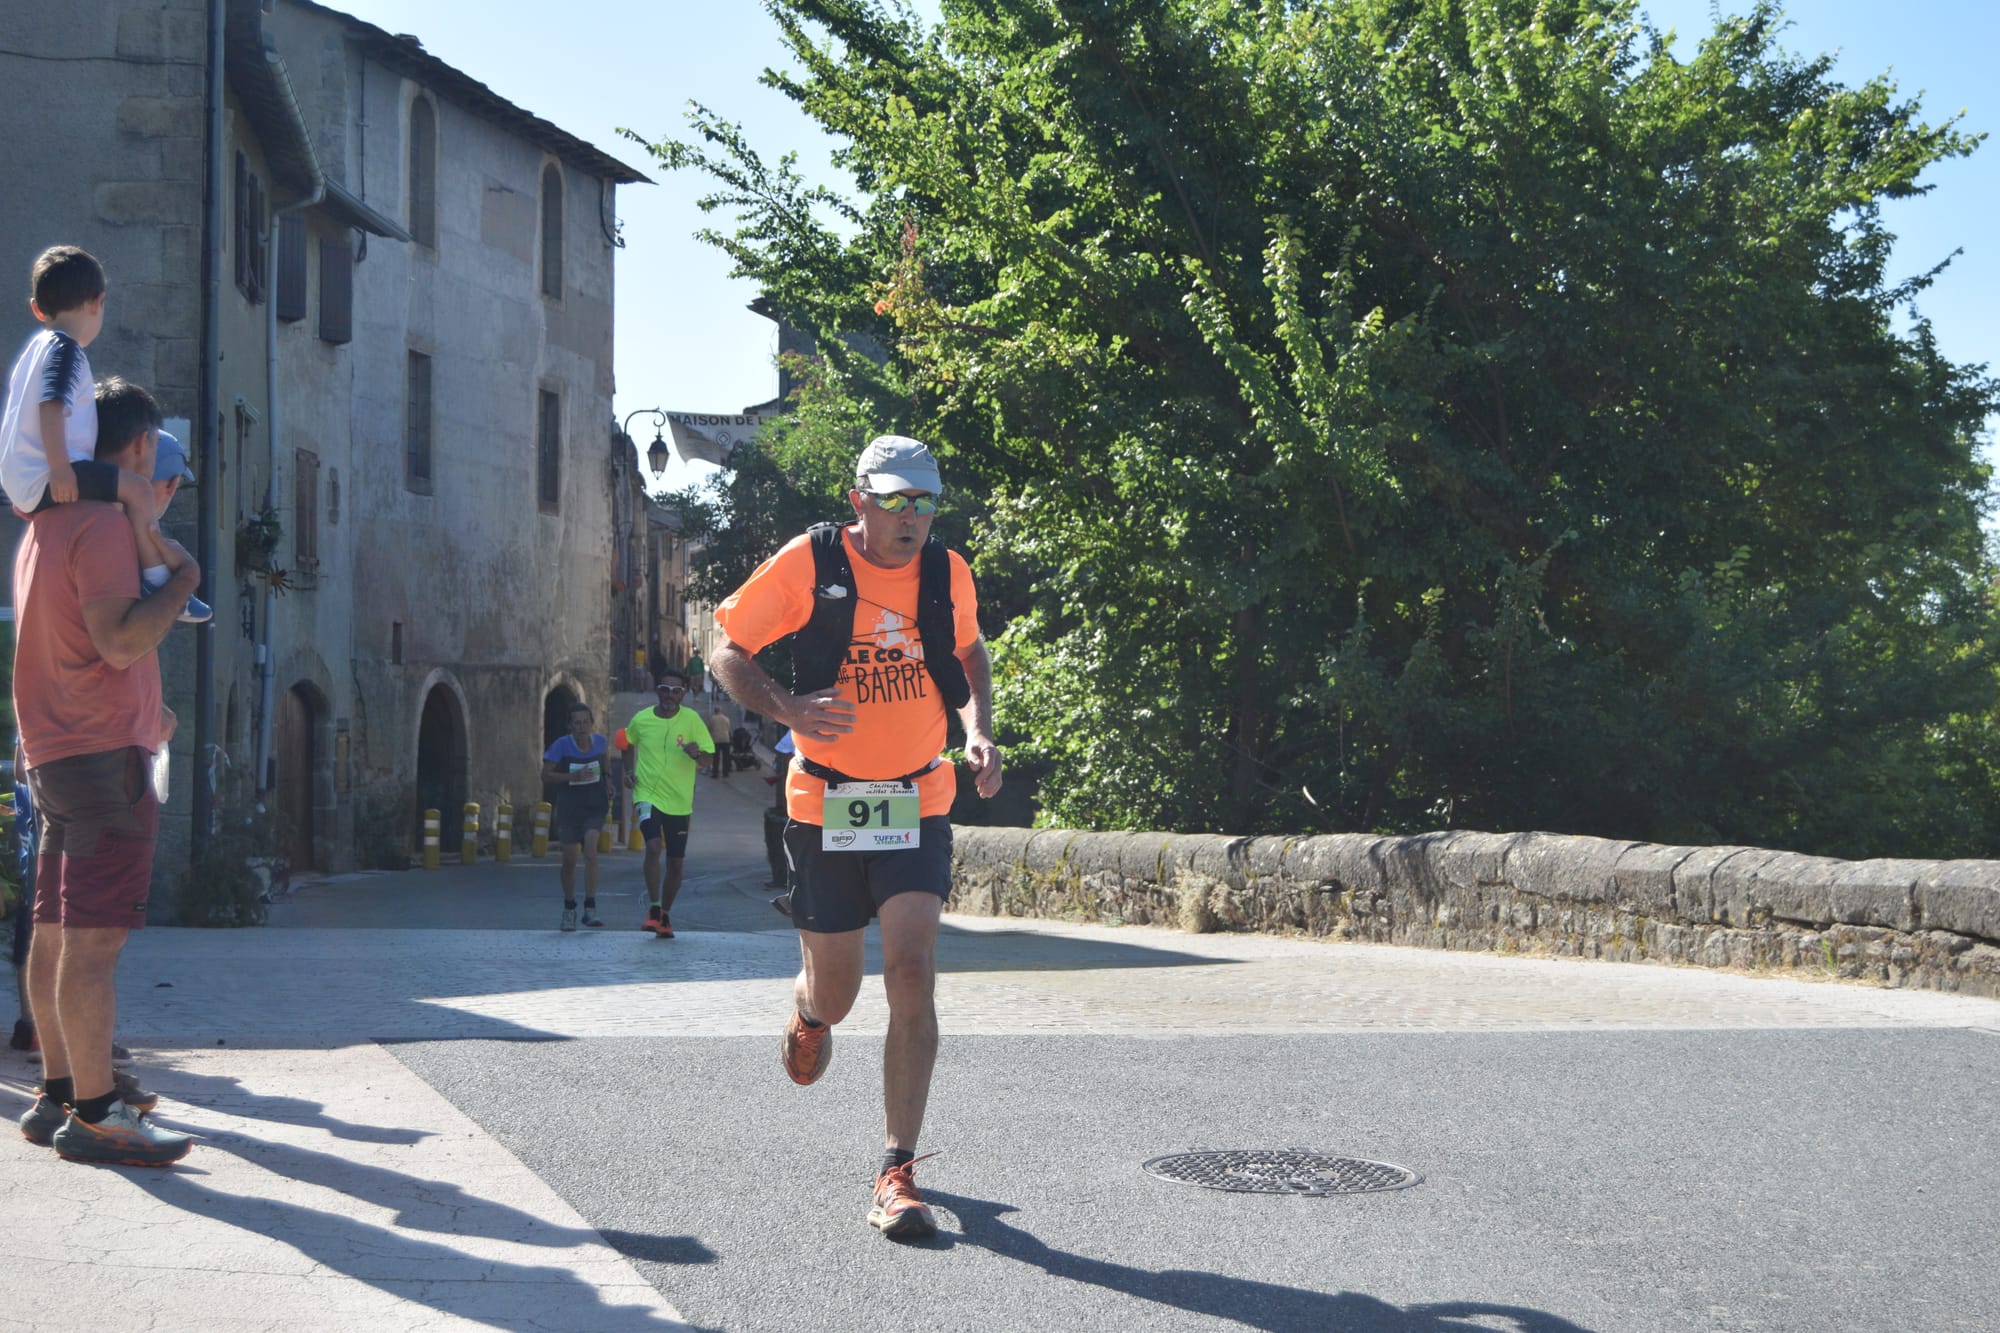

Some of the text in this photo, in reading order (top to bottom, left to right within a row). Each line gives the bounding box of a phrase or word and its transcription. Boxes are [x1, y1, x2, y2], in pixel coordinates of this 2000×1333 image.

[670, 415, 730, 426] MAISON
[735, 415, 752, 426] DE
[847, 649, 870, 664] LE
[855, 661, 927, 704] BARRE
[848, 799, 890, 827] 91
